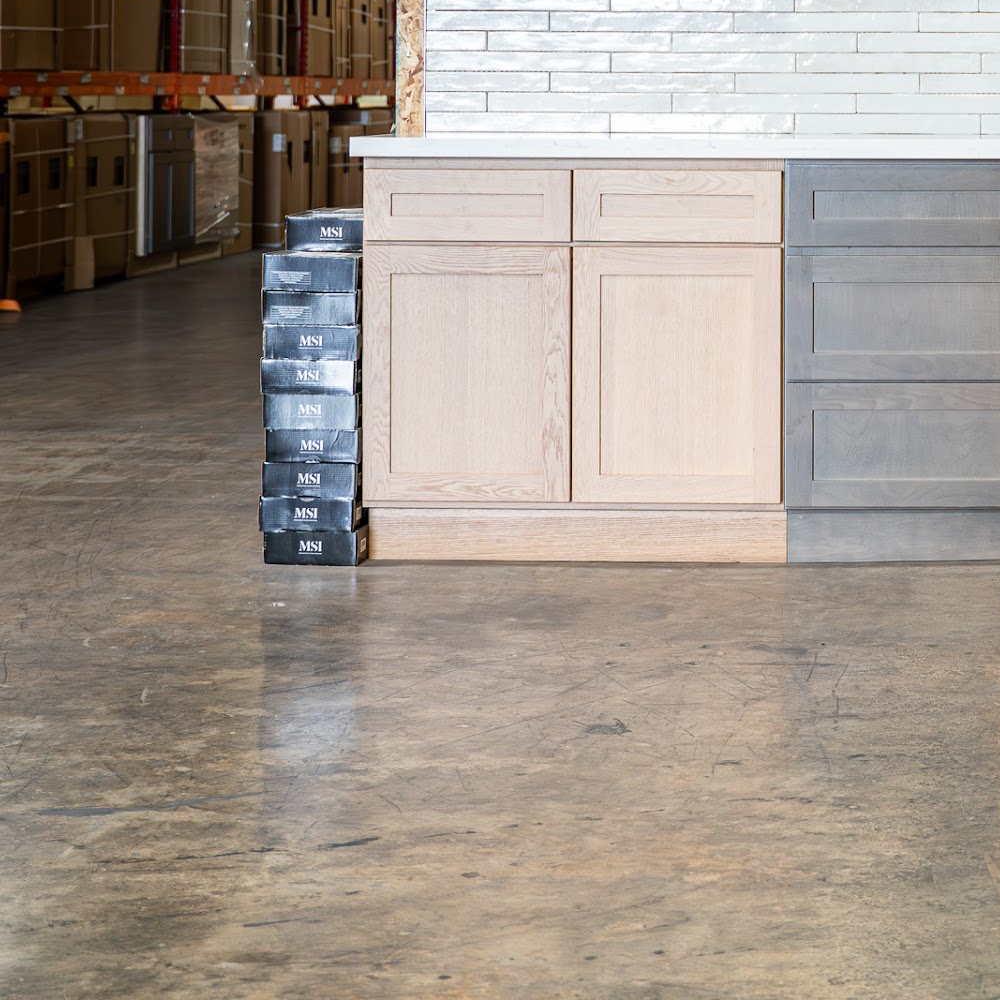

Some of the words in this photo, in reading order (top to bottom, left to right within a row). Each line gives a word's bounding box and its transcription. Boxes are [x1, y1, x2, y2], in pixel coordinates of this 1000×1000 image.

[319, 226, 343, 238] MSI
[299, 335, 323, 347] MSI
[296, 370, 319, 381] MSI
[298, 404, 322, 415] MSI
[300, 440, 324, 451] MSI
[297, 473, 321, 485] MSI
[294, 507, 318, 519] MSI
[298, 540, 322, 552] MSI
